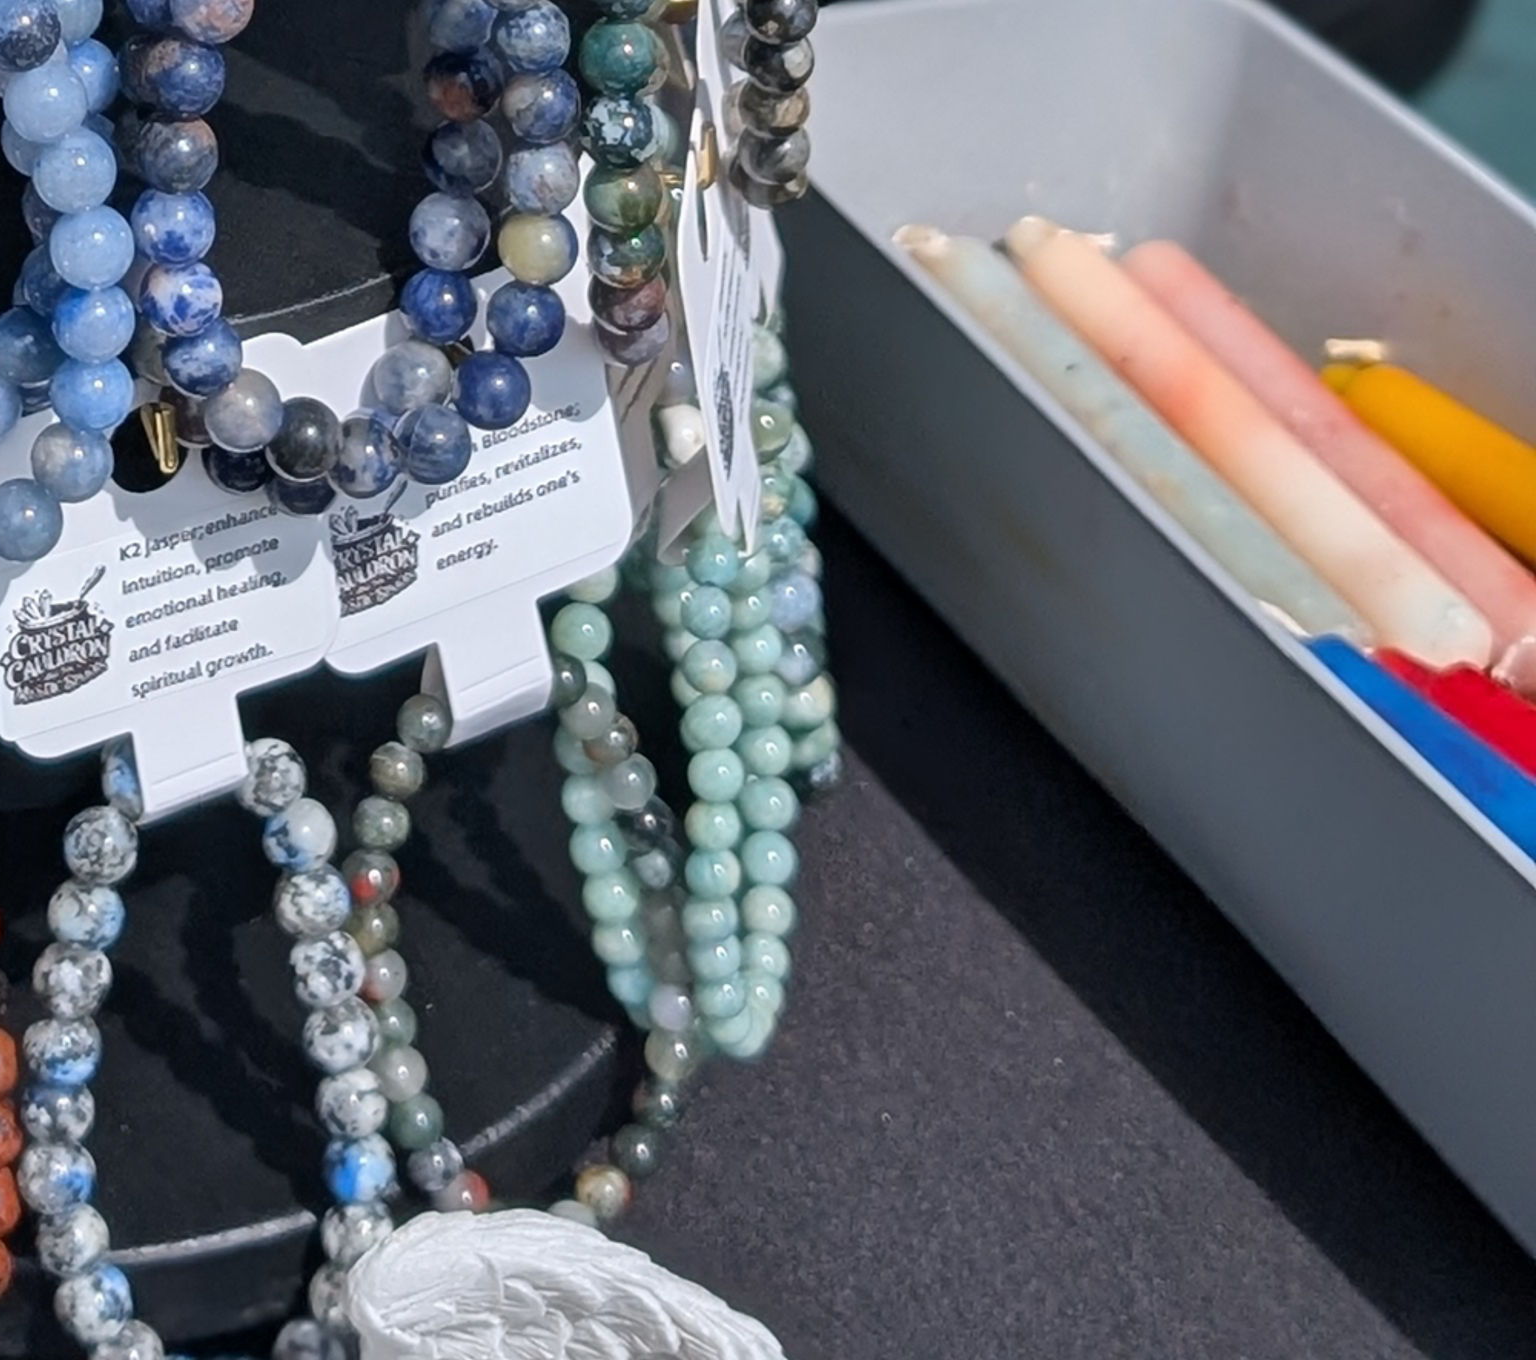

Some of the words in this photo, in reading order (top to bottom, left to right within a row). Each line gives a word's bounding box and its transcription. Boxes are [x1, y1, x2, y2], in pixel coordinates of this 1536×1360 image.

[481, 402, 582, 449] Bloodstone;
[432, 513, 462, 538] and
[466, 489, 534, 525] rebuilds
[536, 469, 581, 496] one's
[119, 542, 142, 562] K2
[205, 536, 280, 574] promote
[436, 539, 499, 571] energy.
[125, 588, 215, 630] emotional
[129, 639, 162, 663] and
[164, 617, 239, 654] facilitate
[131, 661, 203, 699] spiritual
[206, 641, 274, 678] growth.
